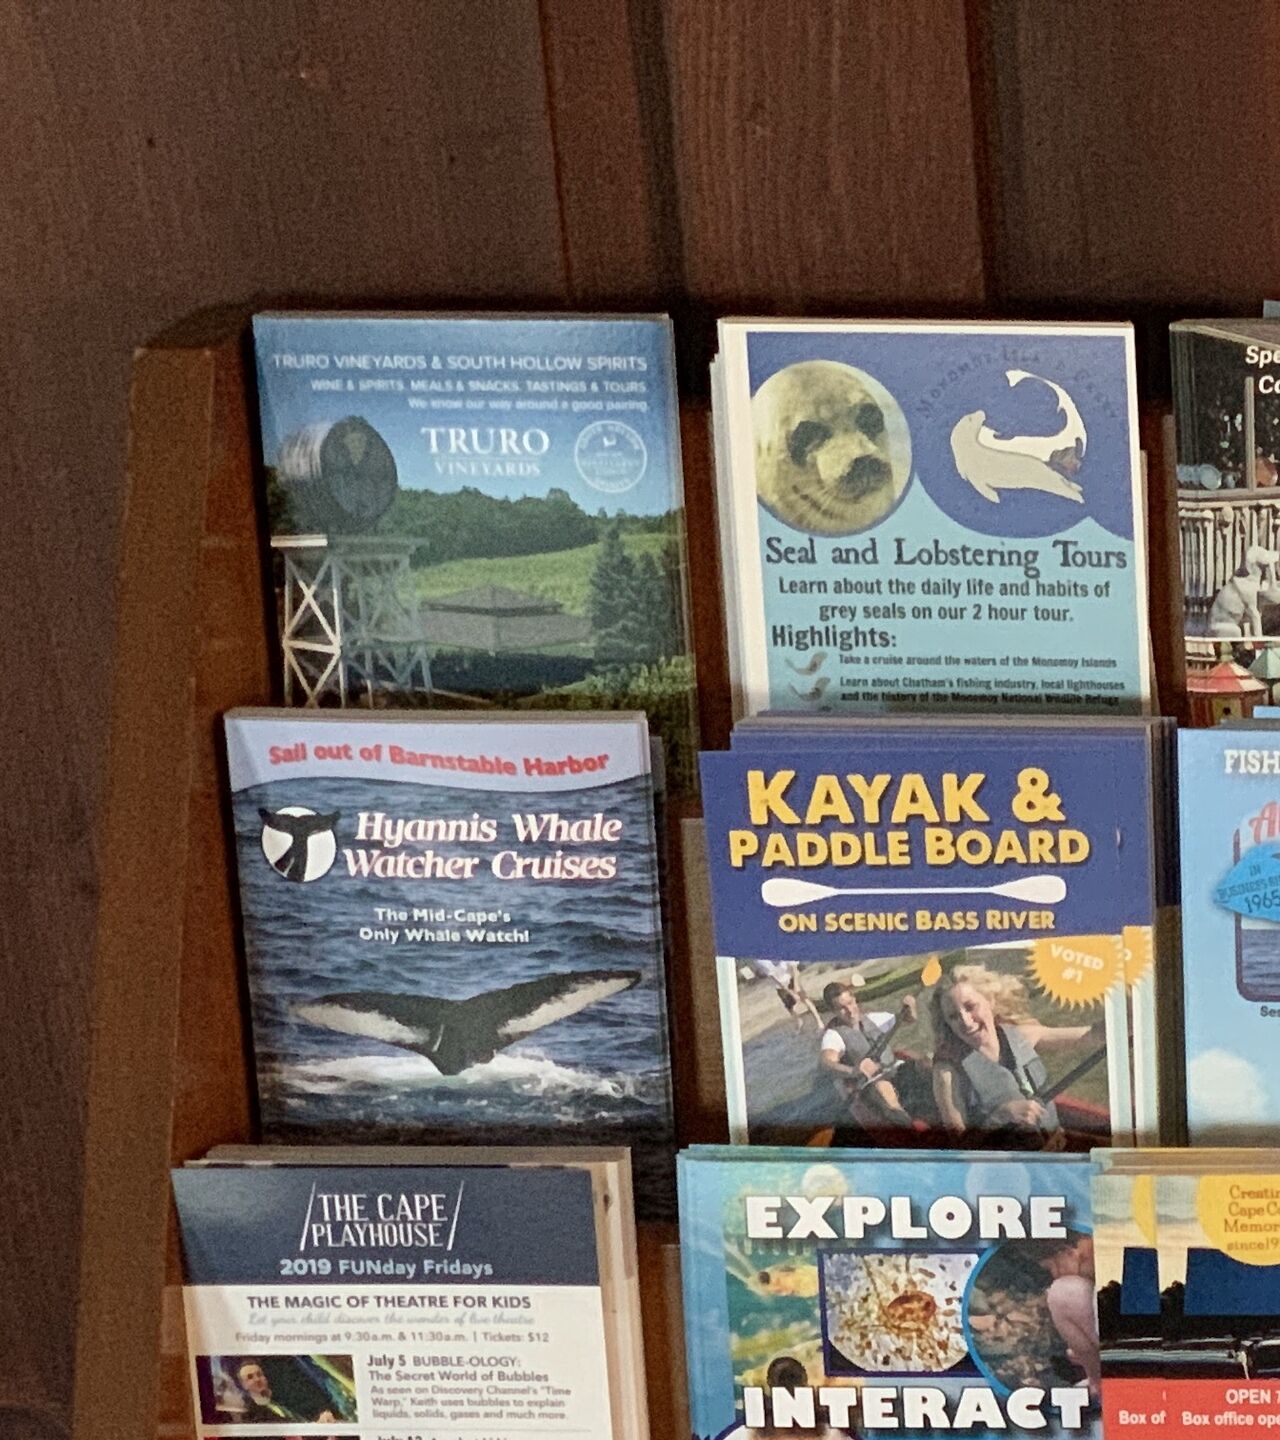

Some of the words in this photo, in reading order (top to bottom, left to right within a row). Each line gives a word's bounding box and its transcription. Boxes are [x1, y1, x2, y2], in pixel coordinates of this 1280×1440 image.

[273, 355, 329, 370] TRURO
[334, 355, 427, 370] VINEYARDS
[432, 356, 442, 370] &
[447, 356, 505, 370] SOUTH
[511, 356, 582, 371] HOLLOW
[587, 356, 647, 371] SPIRITS
[421, 427, 550, 455] TRURO
[434, 459, 540, 476] VINEYARDS
[766, 537, 817, 565] Seal
[832, 540, 878, 565] and
[894, 538, 1040, 578] Lobstering
[1052, 540, 1127, 569] Tours
[772, 625, 897, 651] Highlights:
[747, 769, 990, 826] KAYAK
[1012, 768, 1066, 823] &
[355, 813, 498, 845] Hyannis
[512, 814, 622, 842] Whale
[729, 830, 911, 867] PADDLE
[925, 829, 1090, 865] BOARD
[344, 849, 480, 879] Watcher
[491, 851, 617, 879] Cruises
[318, 1194, 368, 1221] THE
[377, 1194, 447, 1222] CAPE
[745, 1196, 1068, 1239] EXPLORE
[312, 1223, 444, 1246] PLAYHOUSE
[744, 1387, 1090, 1429] INTERACT
